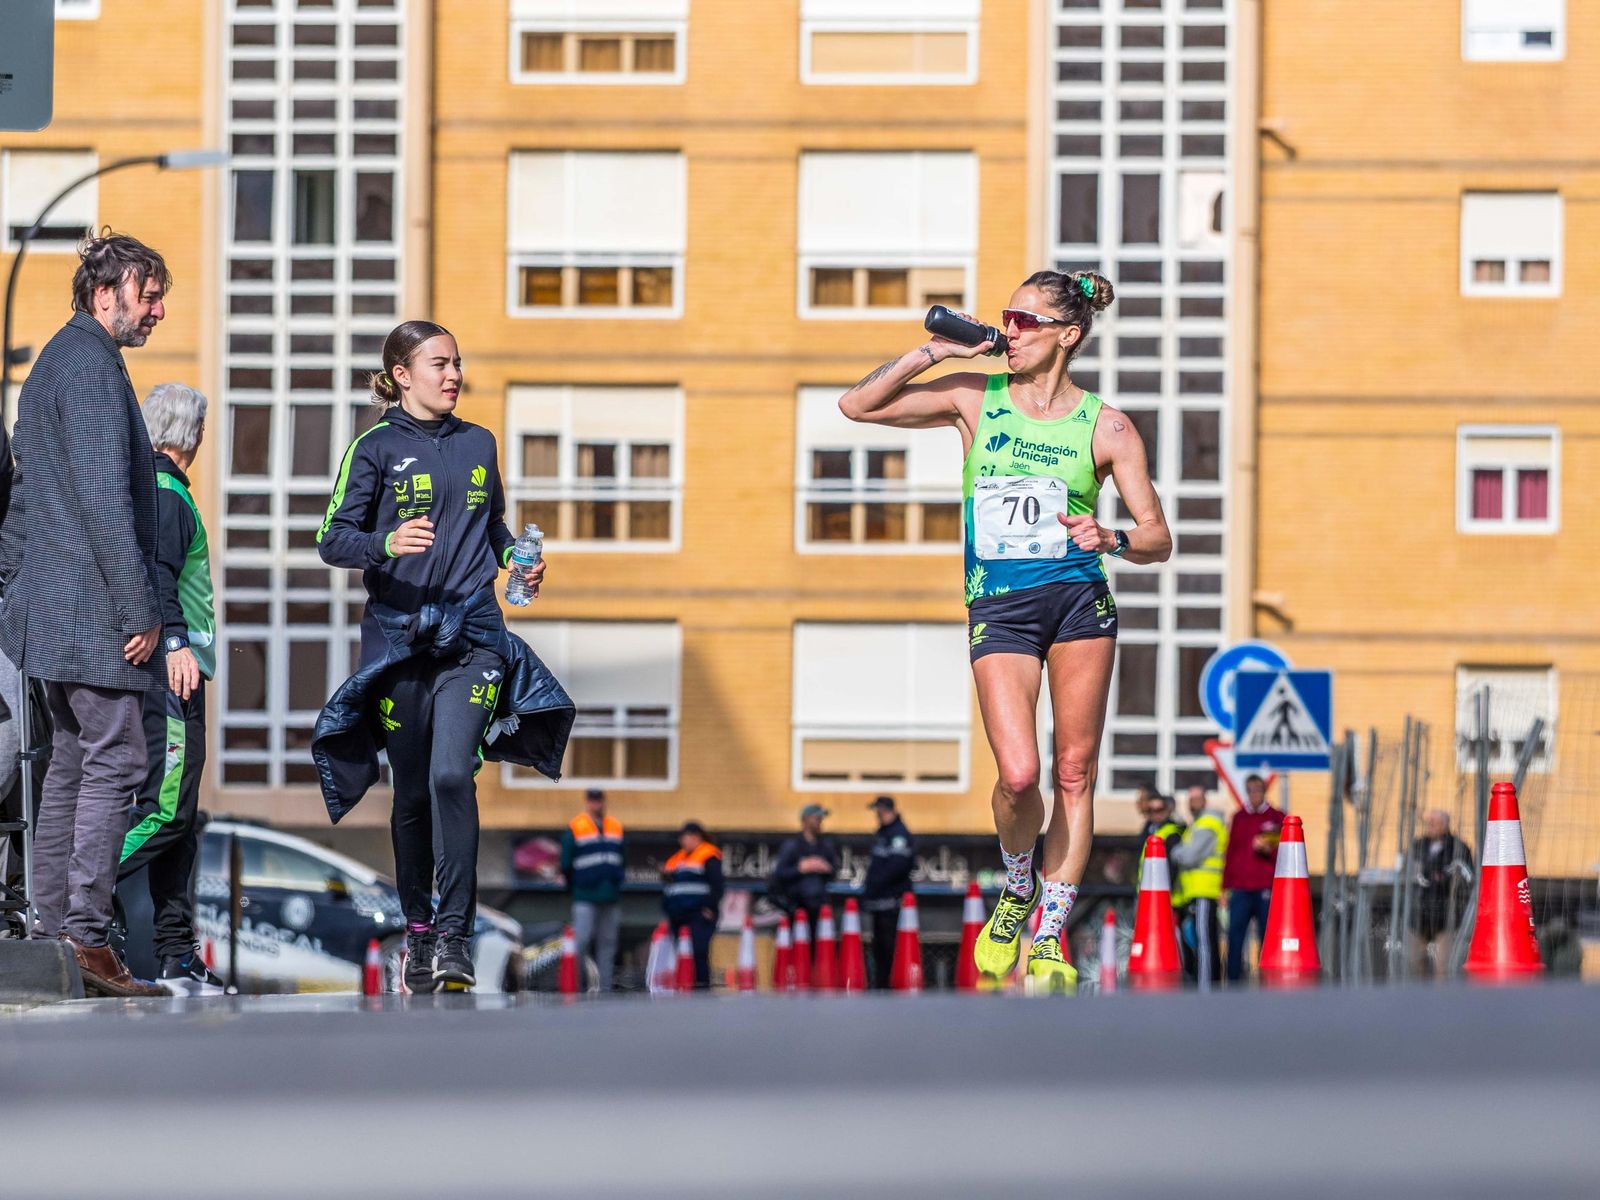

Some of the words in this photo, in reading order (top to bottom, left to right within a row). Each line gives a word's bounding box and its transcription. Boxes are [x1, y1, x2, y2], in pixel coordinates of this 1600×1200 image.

[1012, 447, 1059, 466] Unicaja
[1014, 437, 1078, 458] Fundación
[1009, 461, 1031, 471] Jaén
[1002, 496, 1041, 526] 70
